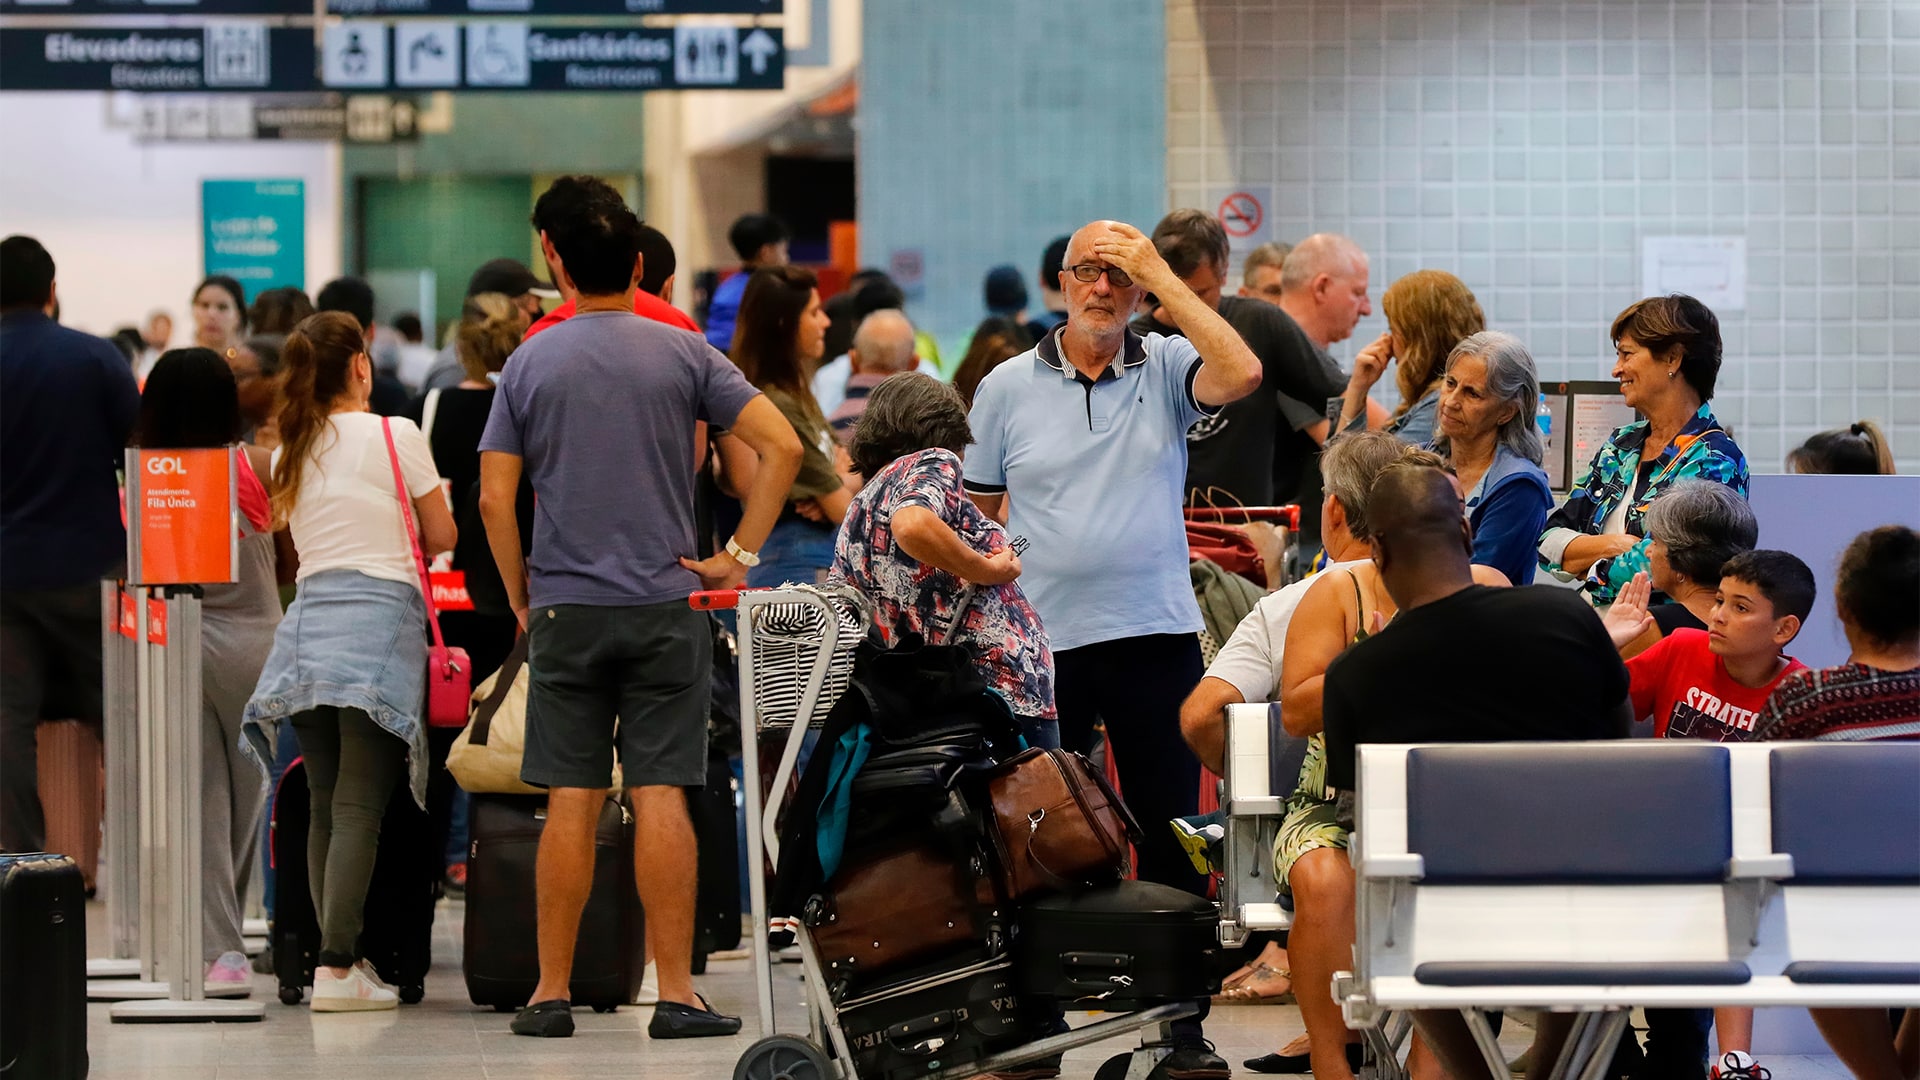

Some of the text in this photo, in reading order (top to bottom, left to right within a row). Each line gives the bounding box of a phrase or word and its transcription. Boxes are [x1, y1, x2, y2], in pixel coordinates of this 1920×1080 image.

[45, 33, 200, 62] Elevadores
[530, 32, 671, 61] Sanitários
[111, 64, 199, 87] Elevators
[565, 64, 661, 86] Restroom
[147, 457, 187, 475] GOL
[147, 488, 190, 496] Atendimento
[147, 495, 197, 508] Fila Única
